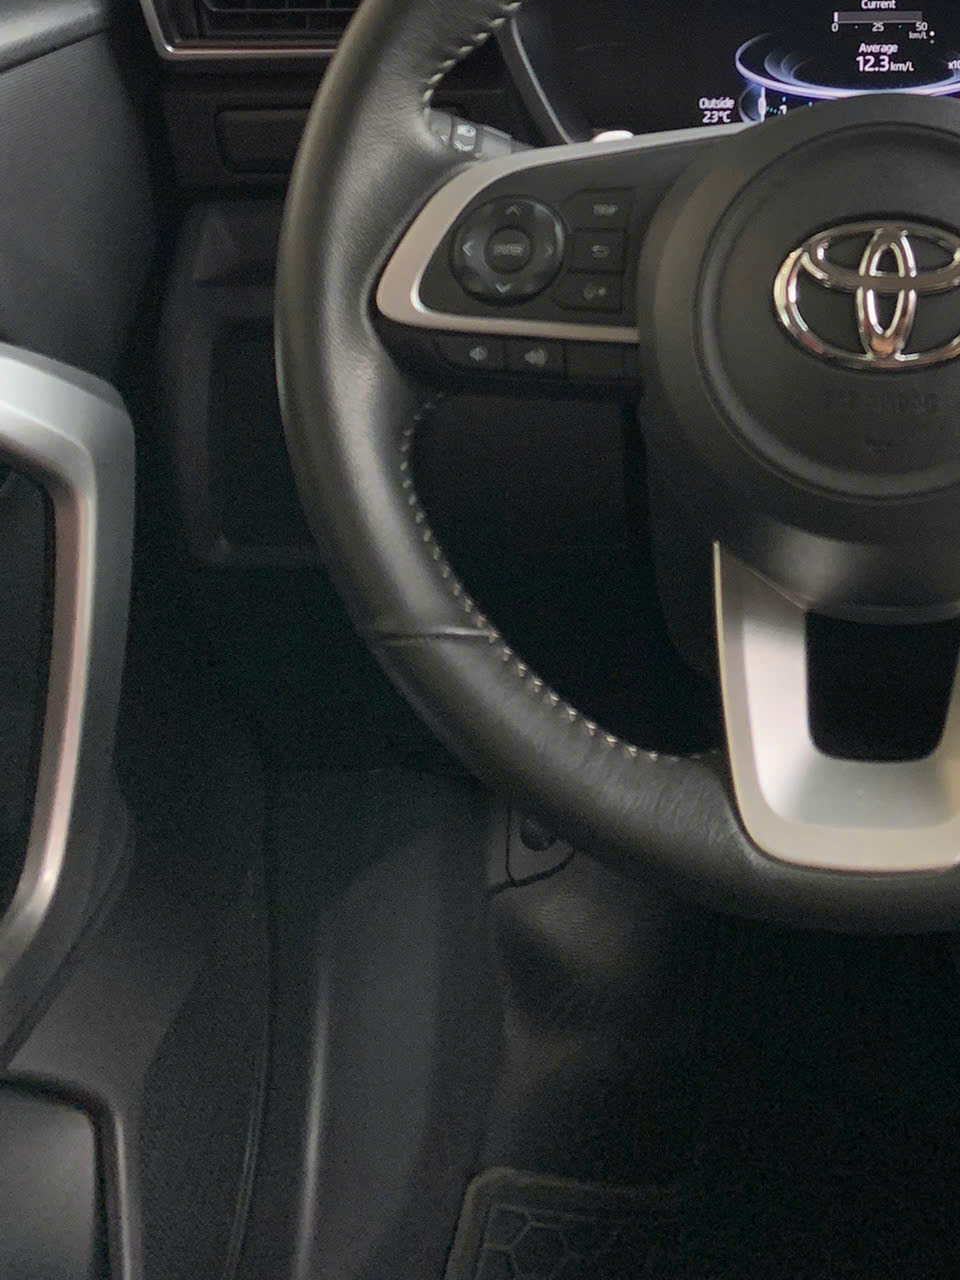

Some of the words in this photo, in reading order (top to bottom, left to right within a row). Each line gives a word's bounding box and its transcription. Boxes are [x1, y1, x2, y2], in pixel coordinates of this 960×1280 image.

[831, 22, 840, 33] 0
[871, 21, 885, 33] 25
[915, 21, 929, 32] 50
[858, 41, 899, 56] Average
[698, 96, 736, 110] Outside
